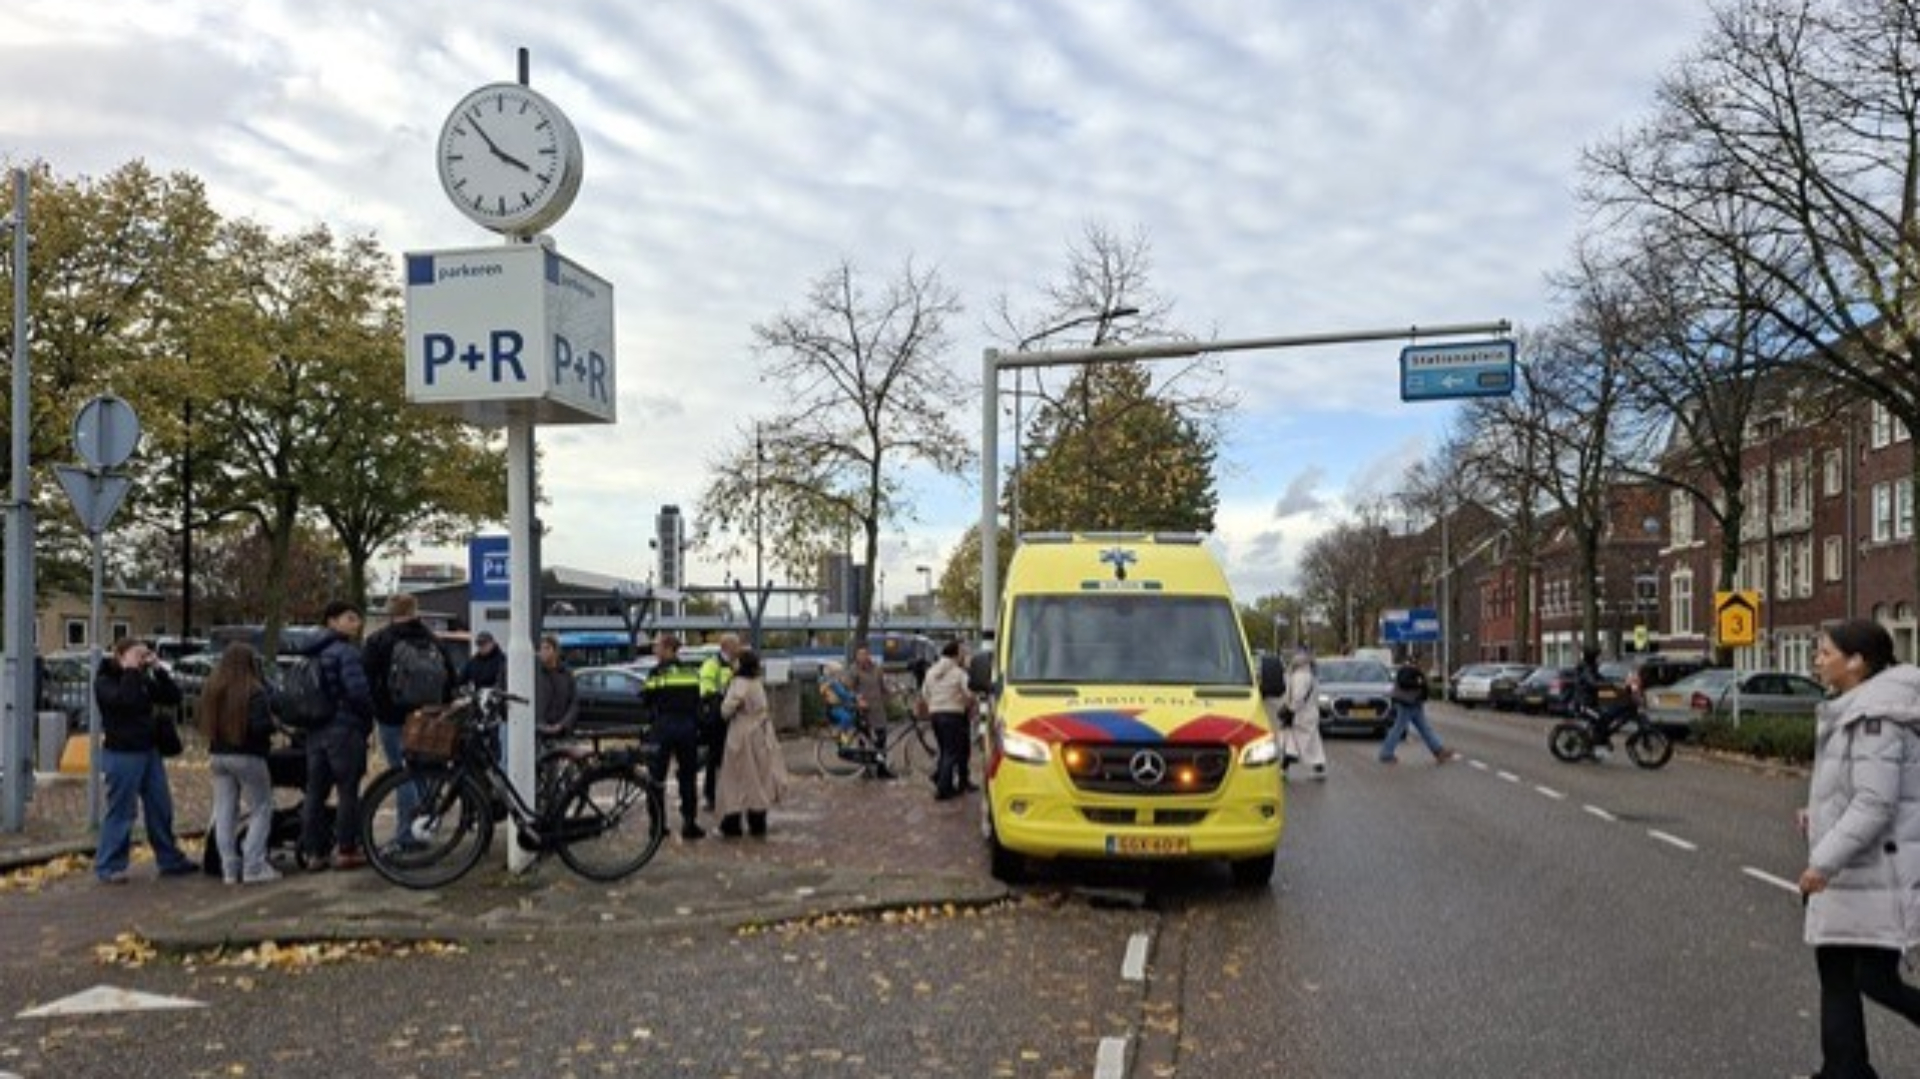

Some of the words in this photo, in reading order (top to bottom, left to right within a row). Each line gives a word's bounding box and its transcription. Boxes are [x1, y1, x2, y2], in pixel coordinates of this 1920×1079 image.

[438, 263, 503, 280] parkeren
[423, 330, 527, 385] P+R
[1412, 351, 1506, 365] Stationsplein
[554, 333, 608, 404] P+R
[1730, 613, 1744, 635] 3
[1066, 697, 1216, 707] AMBULANCE
